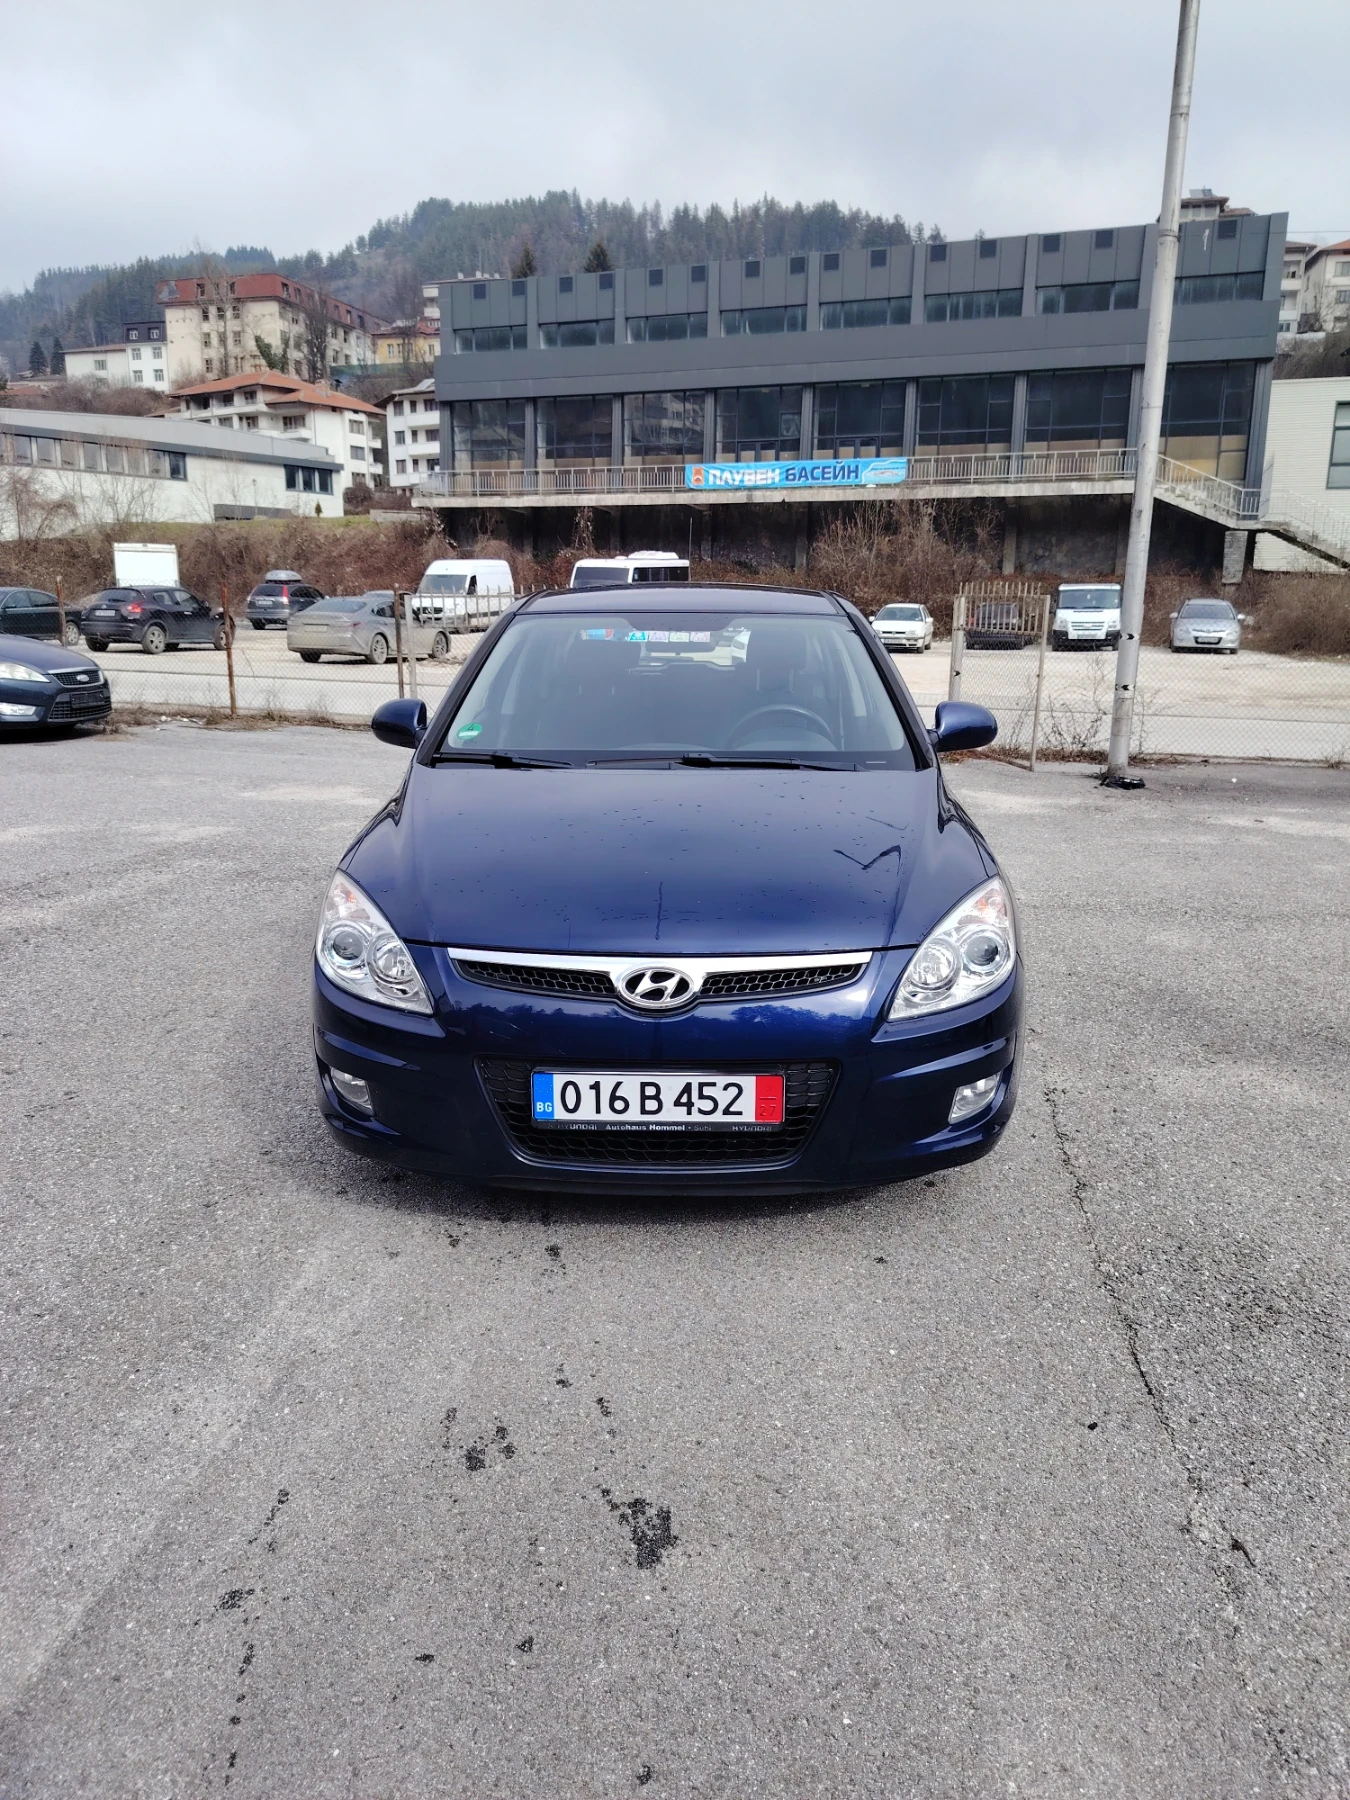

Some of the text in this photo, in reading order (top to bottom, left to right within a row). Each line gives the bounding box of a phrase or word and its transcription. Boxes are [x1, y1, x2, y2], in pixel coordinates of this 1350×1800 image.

[708, 460, 860, 486] ПЛУВЕН БАСЕЙН
[536, 1102, 553, 1113] BG
[759, 1104, 778, 1117] 27
[605, 1124, 647, 1132] Autohaus
[649, 1124, 685, 1132] Hommel
